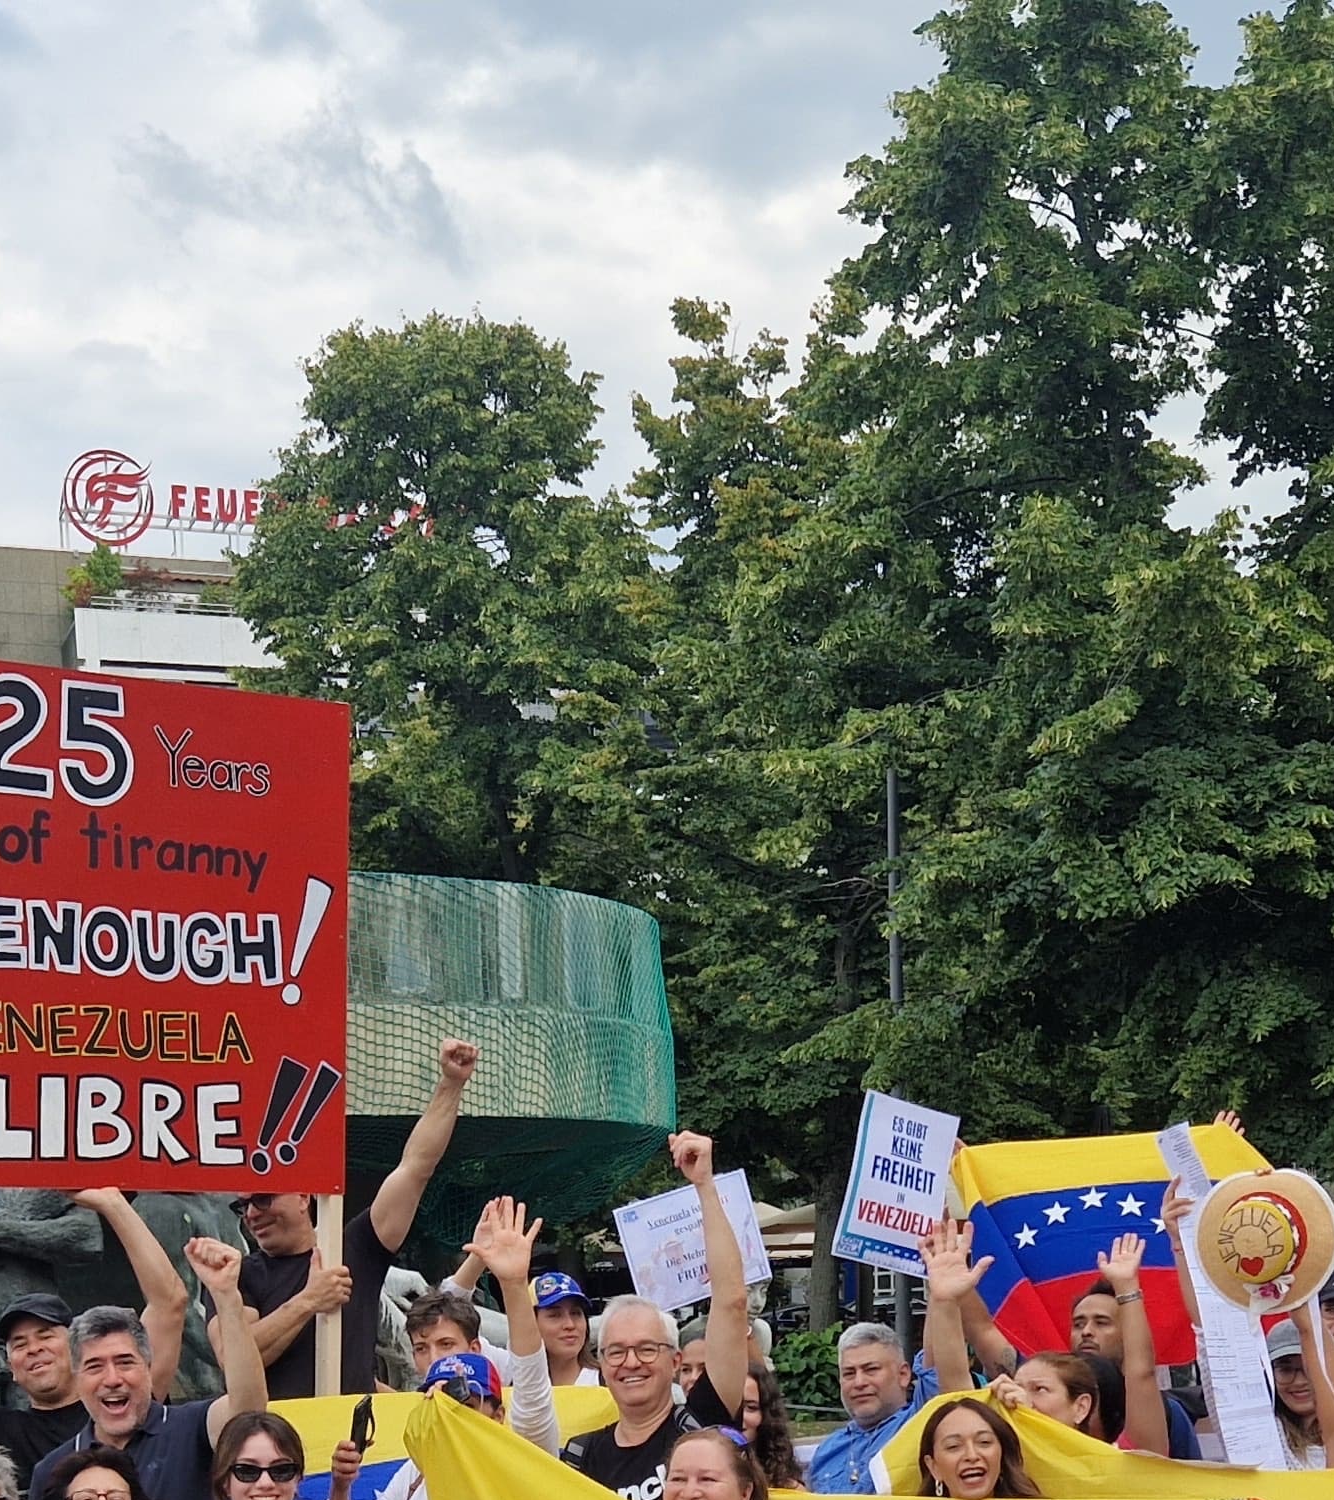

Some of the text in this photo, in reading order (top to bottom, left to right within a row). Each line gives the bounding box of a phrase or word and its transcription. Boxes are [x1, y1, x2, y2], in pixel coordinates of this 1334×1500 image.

[154, 724, 272, 798] Years
[80, 822, 269, 894] tiranny
[893, 1115, 929, 1140] ES GIBT
[892, 1135, 924, 1162] KEINE
[871, 1155, 936, 1195] FREIHEIT
[647, 1208, 691, 1229] Venezuela
[857, 1198, 935, 1238] VENEZUELA
[1218, 1207, 1285, 1273] VENEZUELA
